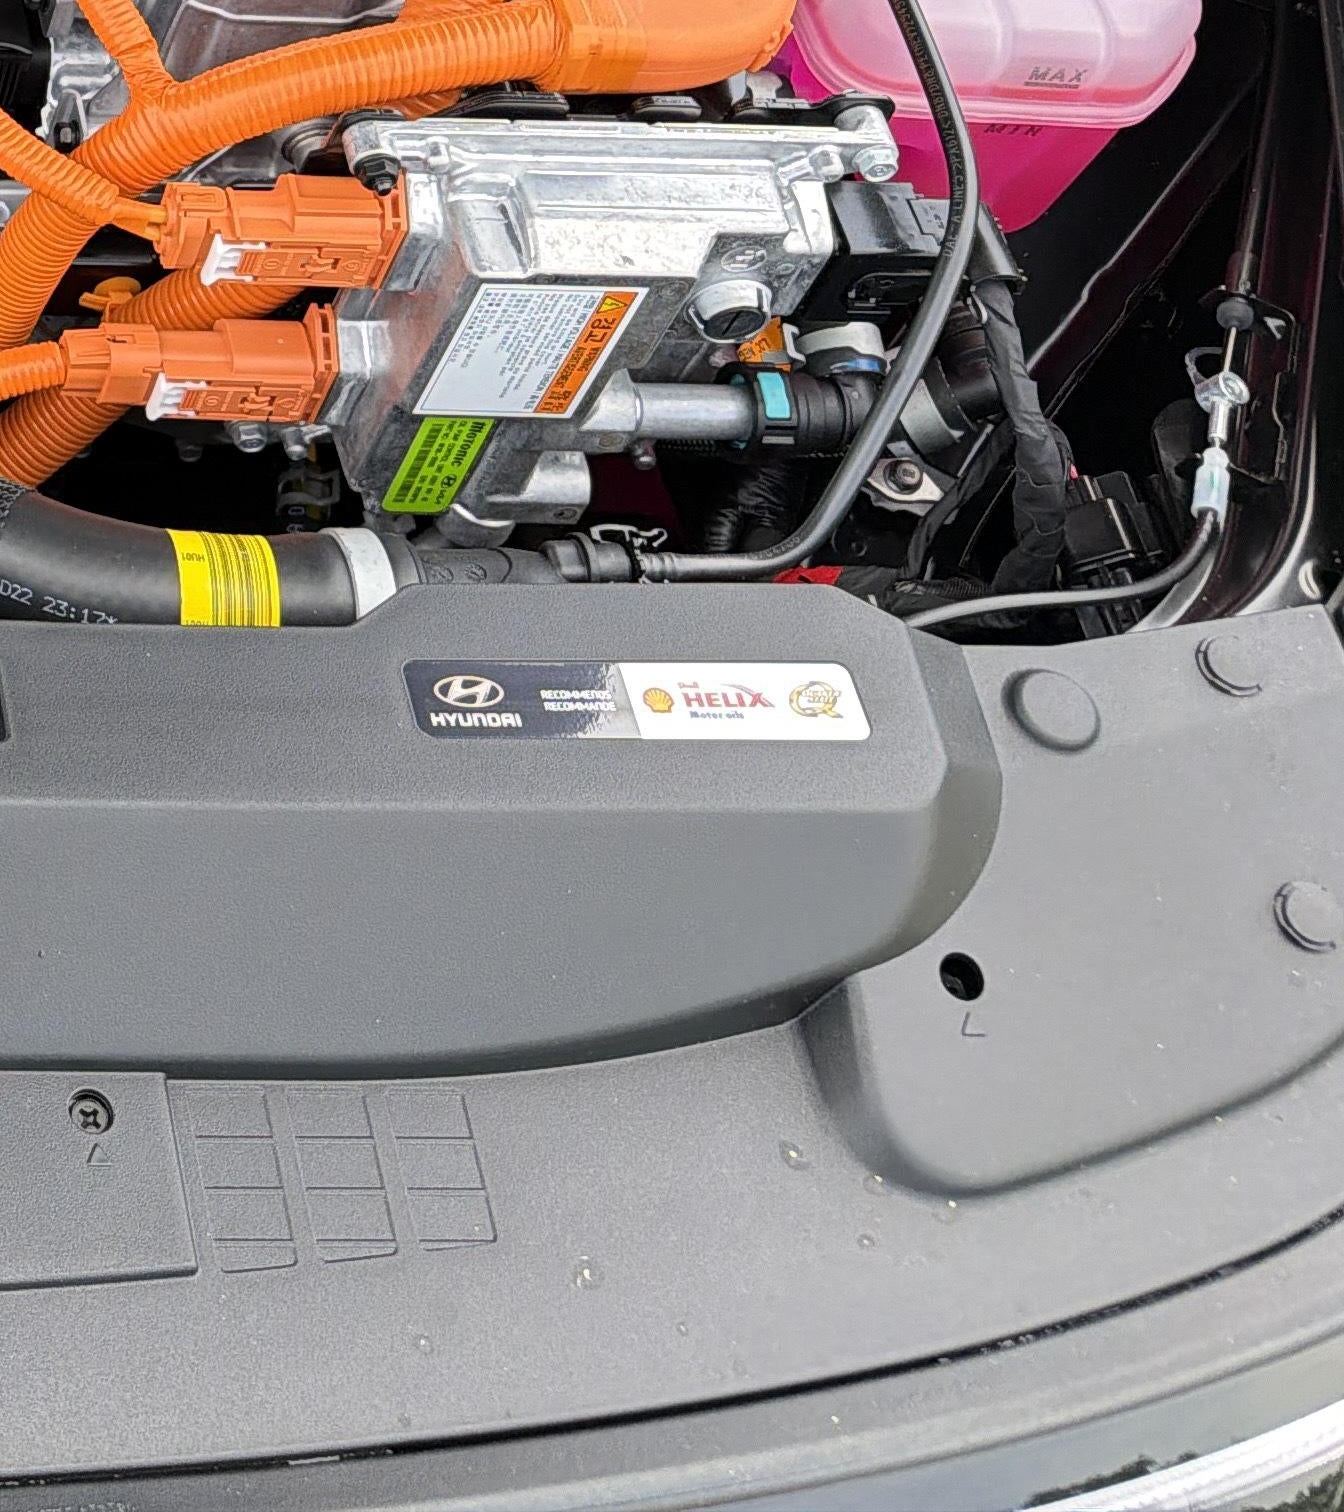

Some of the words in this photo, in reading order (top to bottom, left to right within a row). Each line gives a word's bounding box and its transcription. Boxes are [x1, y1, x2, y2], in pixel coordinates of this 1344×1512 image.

[1027, 66, 1088, 83] MAX
[984, 123, 1043, 137] MIN
[539, 689, 613, 700] RECOMMENDS
[681, 691, 774, 708] HELIX
[429, 712, 523, 728] HYUNDAI
